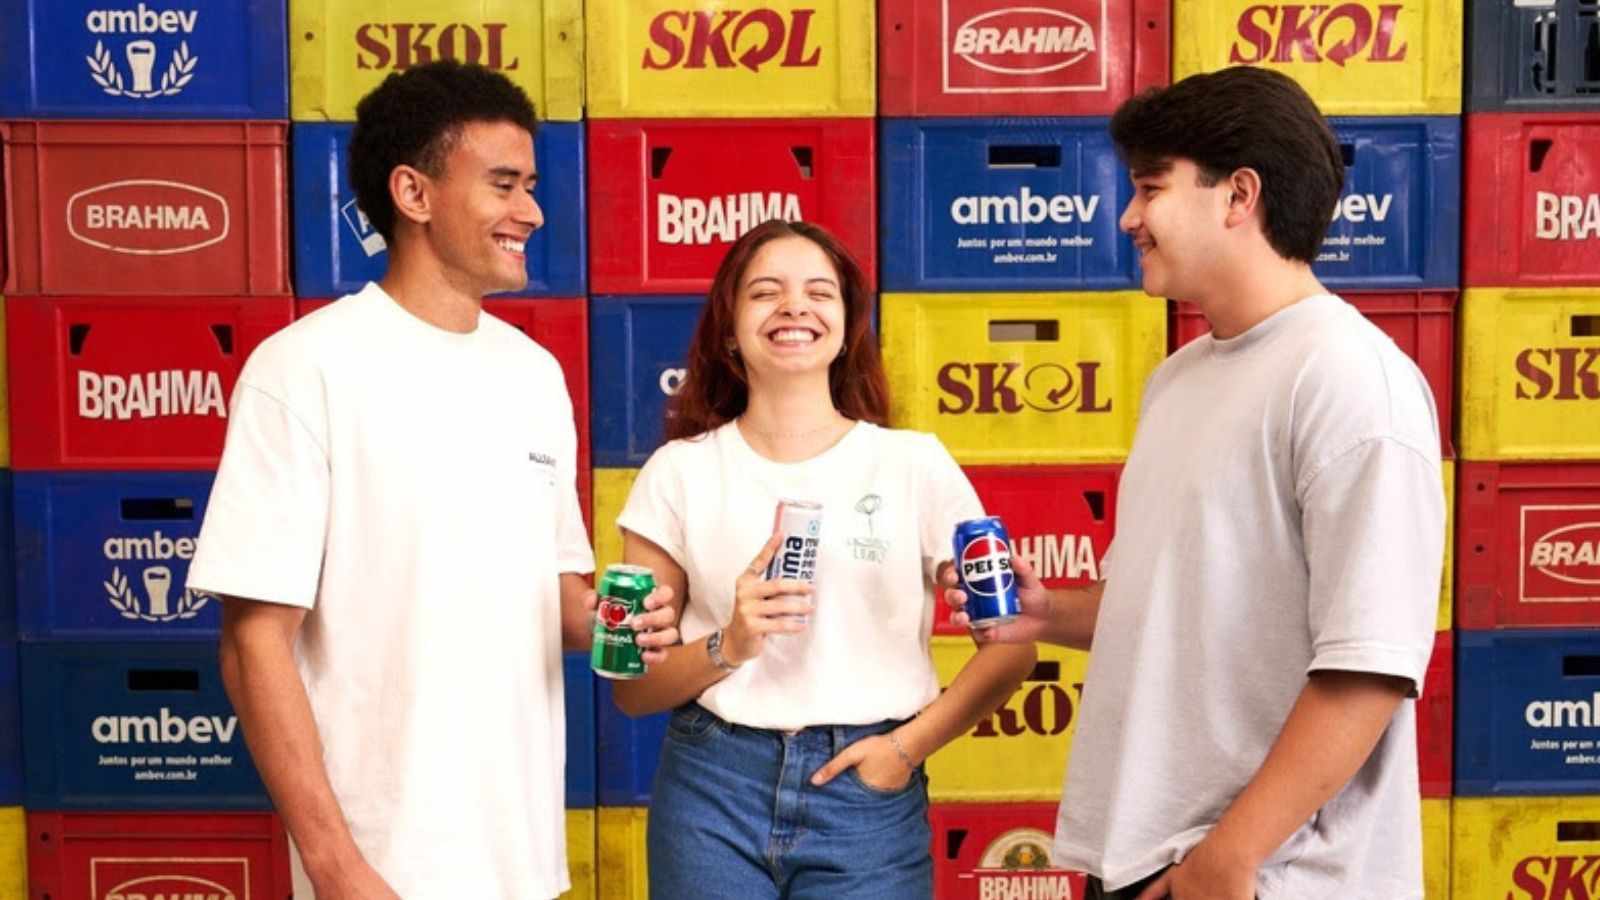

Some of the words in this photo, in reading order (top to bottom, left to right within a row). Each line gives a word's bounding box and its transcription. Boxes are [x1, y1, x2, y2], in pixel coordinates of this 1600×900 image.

[86, 3, 198, 33] ambev
[1229, 3, 1407, 67] SKOL
[355, 23, 518, 70] SKOL
[641, 8, 821, 73] SKOL
[953, 25, 1096, 54] BRAHMA
[86, 204, 210, 230] BRAHMA
[657, 191, 803, 245] BRAHMA
[951, 186, 1100, 224] ambev
[957, 237, 987, 248] Juntos
[990, 238, 1006, 249] por
[1007, 238, 1023, 247] um
[1025, 236, 1057, 247] mundo
[1060, 236, 1093, 247] melhor
[78, 370, 228, 420] BRAHMA
[937, 362, 1113, 414] SKOL
[103, 530, 199, 560] ambe
[1010, 534, 1098, 581] HMA
[1530, 541, 1600, 567] BRA
[91, 707, 238, 743] ambev
[98, 755, 128, 766] Juntos
[130, 756, 146, 767] por
[147, 756, 162, 766] um
[165, 754, 198, 766] mundo
[200, 754, 232, 766] melhor
[980, 876, 1073, 900] BRAHMA
[1505, 855, 1600, 900] SK
